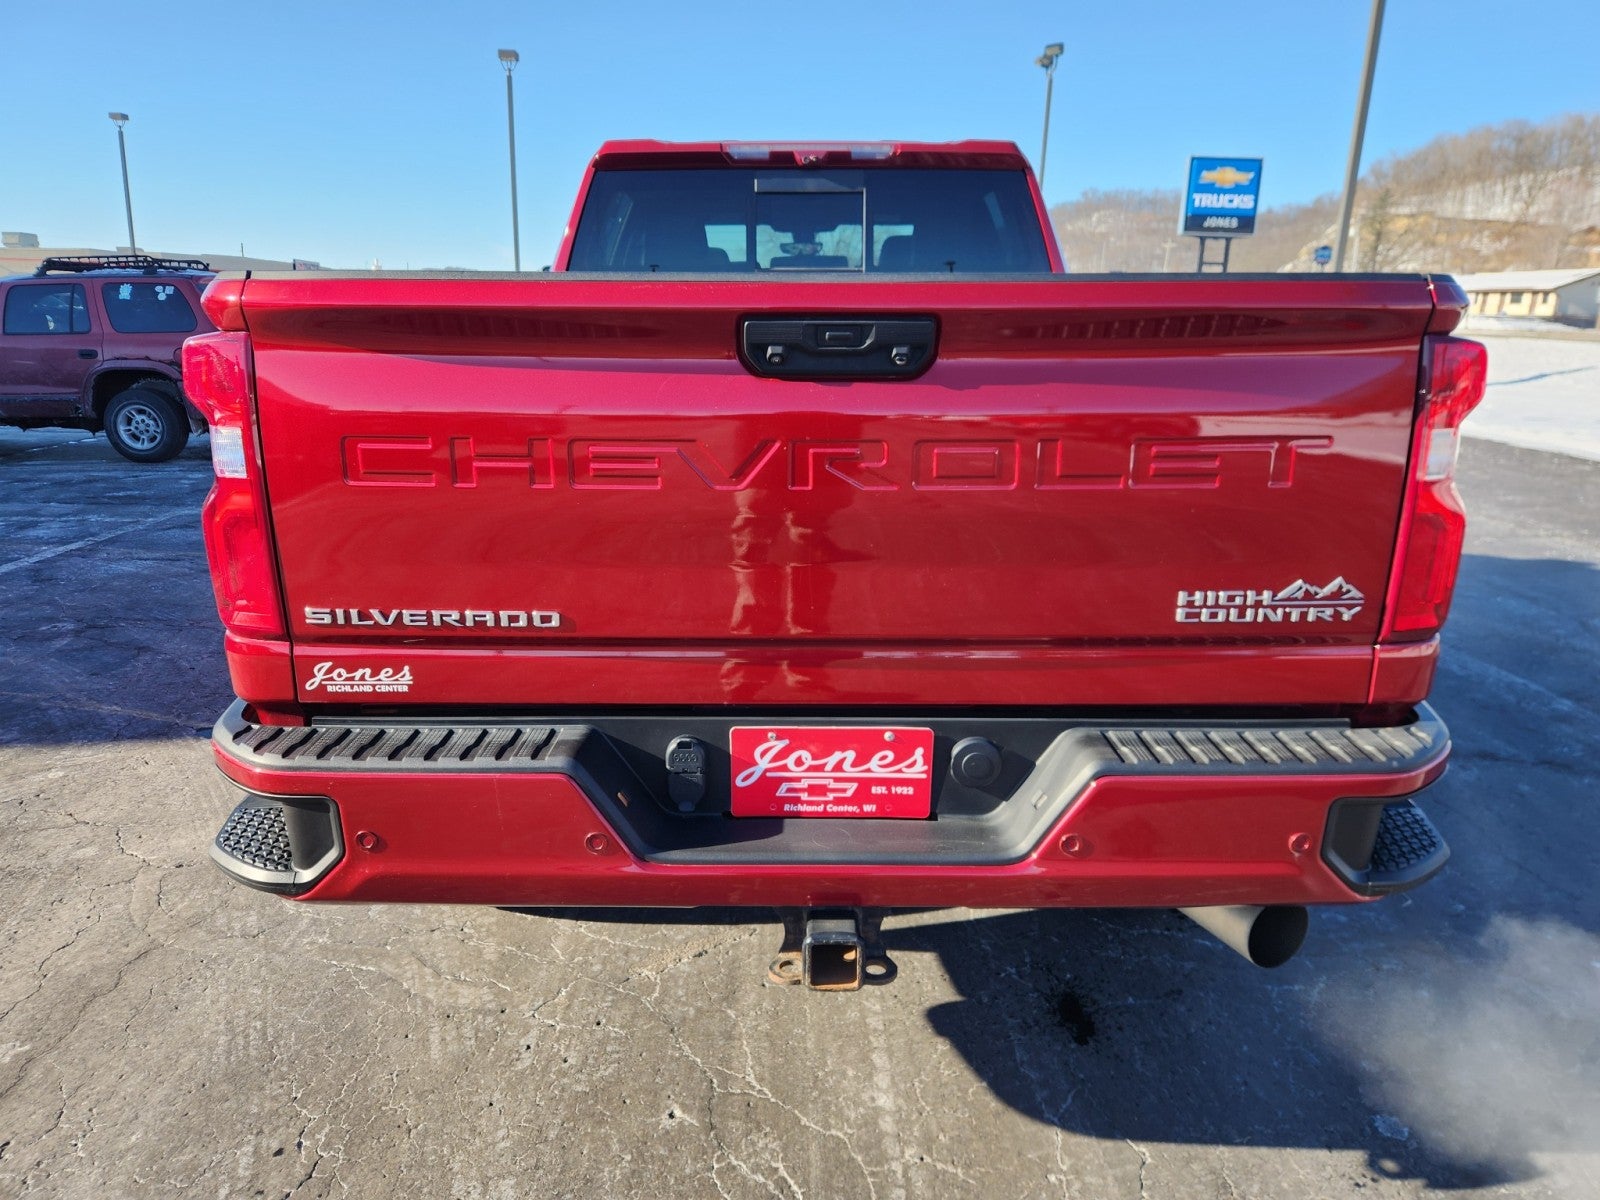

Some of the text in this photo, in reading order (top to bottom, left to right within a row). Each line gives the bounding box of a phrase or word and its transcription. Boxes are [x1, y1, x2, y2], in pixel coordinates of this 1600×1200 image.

[1192, 193, 1255, 209] TRUCKS
[1203, 216, 1239, 229] JONES
[341, 435, 1334, 491] CHEVROLET
[1177, 590, 1273, 606] HIGH
[305, 606, 560, 627] SILVERADO
[1175, 606, 1363, 623] COUNTRY
[305, 661, 413, 691] Jones
[326, 684, 409, 693] RICHLAND CENTER
[735, 739, 929, 788] Jones
[871, 786, 888, 795] EST.
[783, 804, 877, 813] Richland Center, WI
